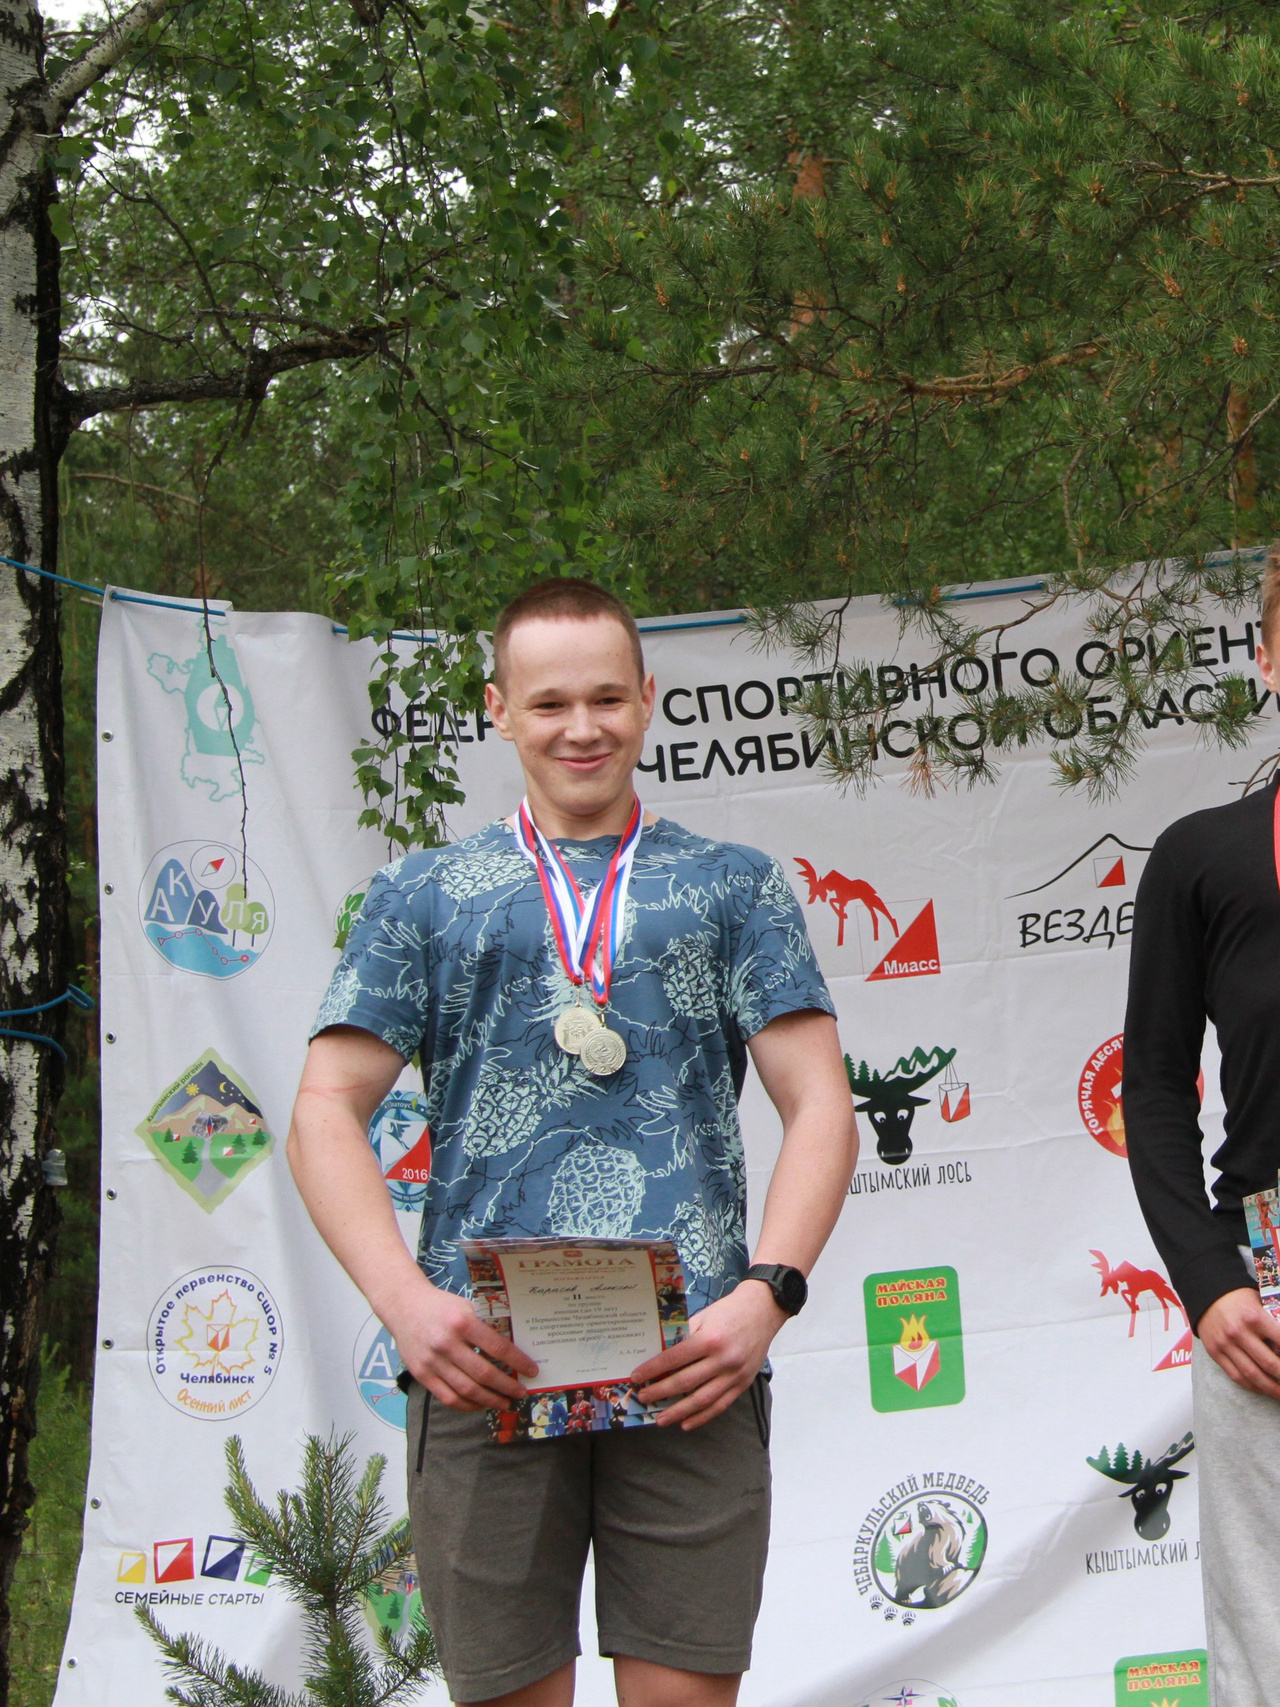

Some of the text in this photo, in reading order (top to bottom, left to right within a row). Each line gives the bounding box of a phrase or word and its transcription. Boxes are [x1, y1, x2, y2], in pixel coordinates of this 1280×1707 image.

[1018, 901, 1134, 950] ВЕЗДЕ
[884, 958, 938, 975] Миасс
[1081, 1037, 1124, 1135] ГОРЯЧАЯ ДЕСЯ
[402, 1168, 428, 1180] 2016
[847, 1161, 972, 1195] ШТЫМСКИЙ ЛОСЬ
[518, 1258, 634, 1268] ГРАМОТА
[876, 1276, 947, 1295] МАЙСКАЯ
[876, 1290, 947, 1307] ПОЛЯНА
[155, 1274, 278, 1375] Открытое первенство СШОР № 5
[180, 1372, 255, 1384] Челябинск
[177, 1387, 252, 1413] Осенний лист
[853, 1472, 990, 1595] ЧЕБАРКУЛЬСКИЙ МЕДВЕДЬ
[1085, 1539, 1187, 1574] КЫШТЫМСКИЙ
[115, 1589, 265, 1605] СЕМЕЙНЫЕ СТАРТЫ
[1127, 1660, 1201, 1679] МАЙСКАЯ
[1127, 1673, 1201, 1691] ПОЛЯНА
